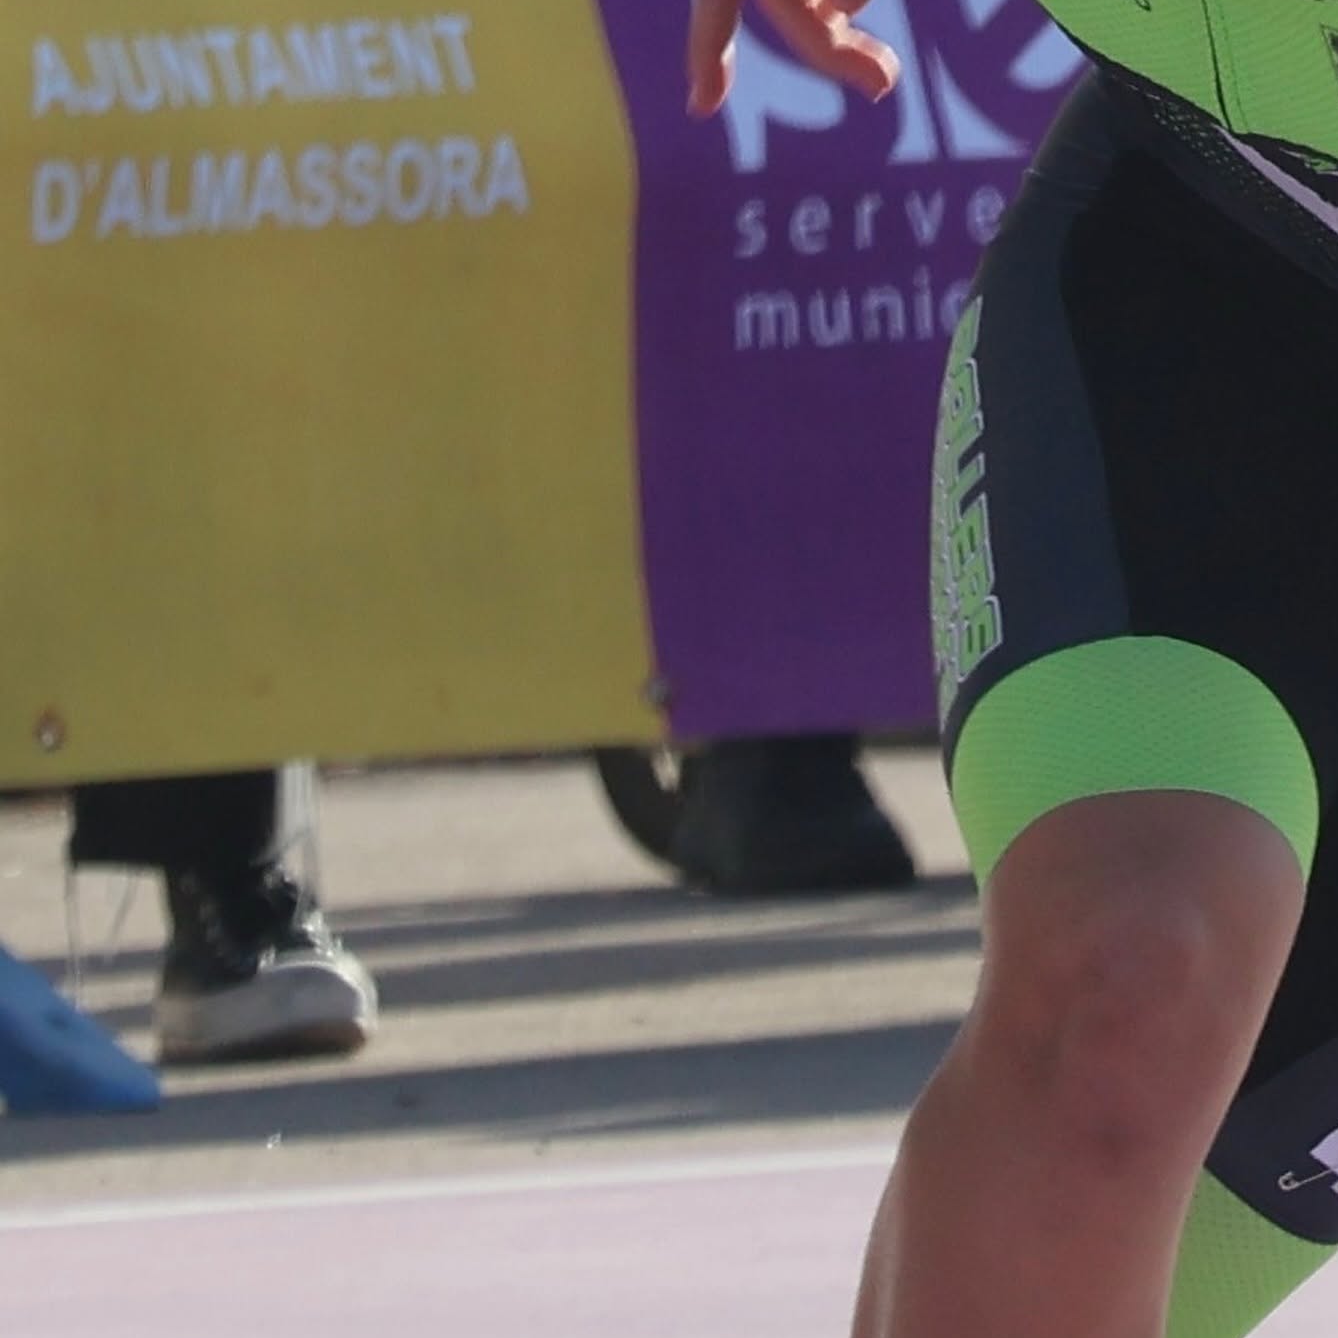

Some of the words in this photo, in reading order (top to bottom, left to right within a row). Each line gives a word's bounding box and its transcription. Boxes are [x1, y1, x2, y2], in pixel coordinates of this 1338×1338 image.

[30, 13, 476, 118] AJUNTAMENT
[30, 133, 531, 244] D'ALMASSORA
[735, 186, 1006, 259] serve
[734, 264, 972, 351] munic
